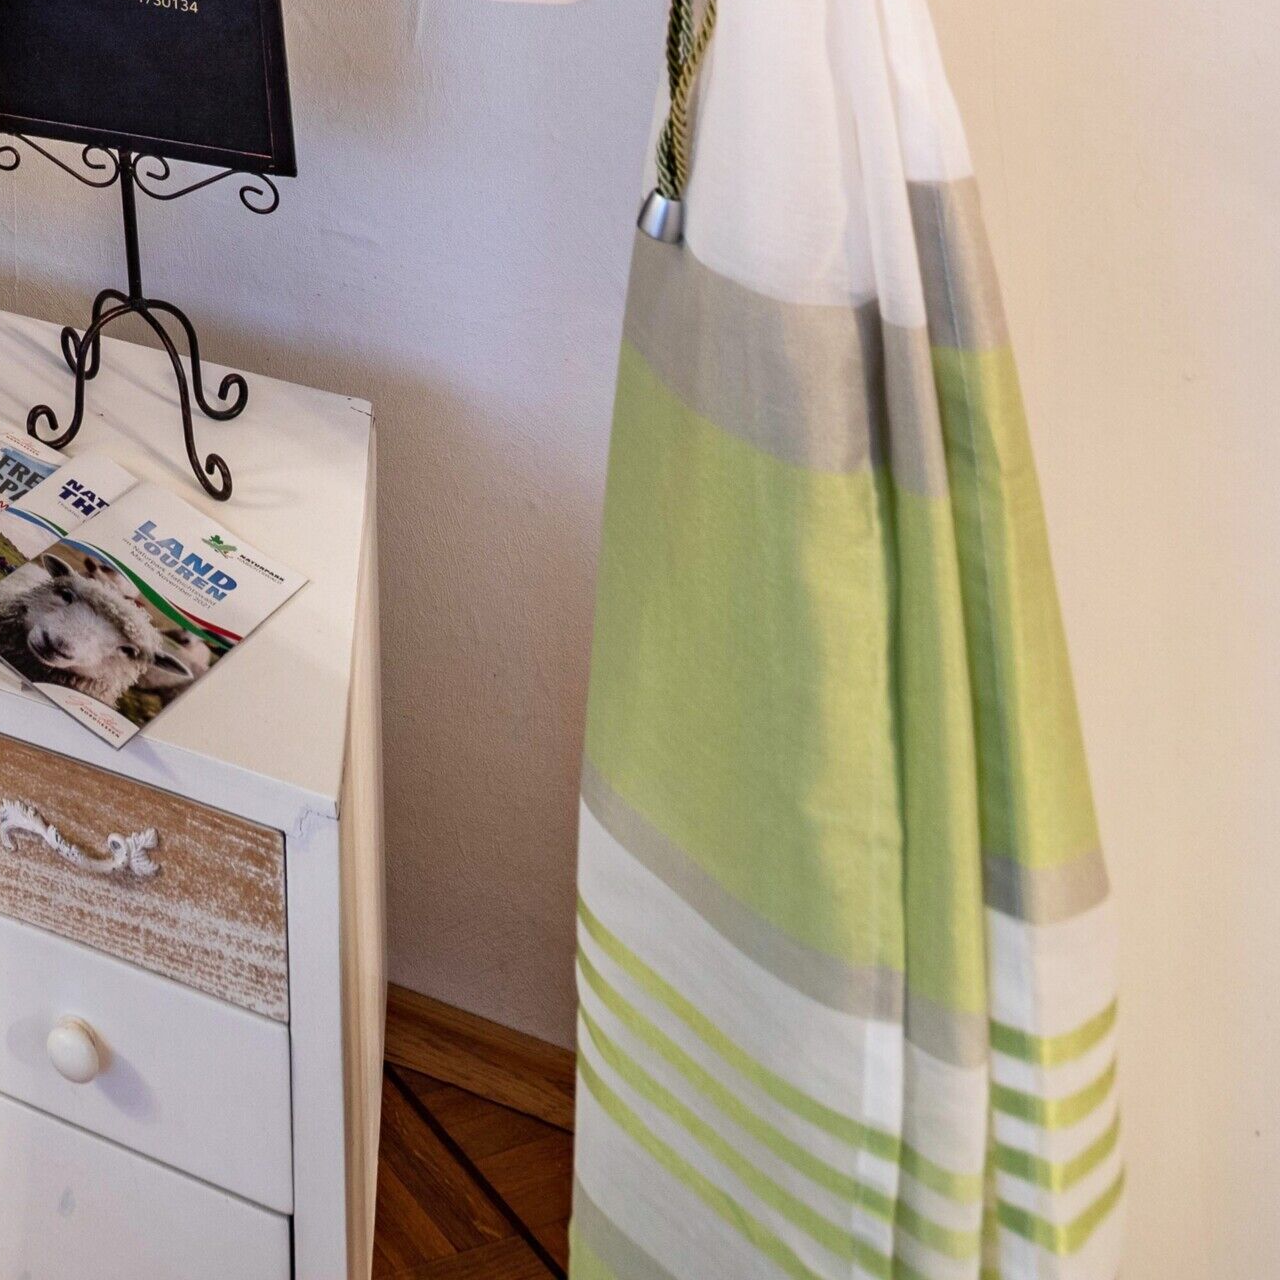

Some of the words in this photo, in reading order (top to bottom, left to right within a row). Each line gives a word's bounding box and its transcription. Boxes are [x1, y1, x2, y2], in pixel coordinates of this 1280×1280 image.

[65, 478, 110, 510] NAT
[131, 530, 228, 602] TOUREN
[137, 520, 238, 593] LAND
